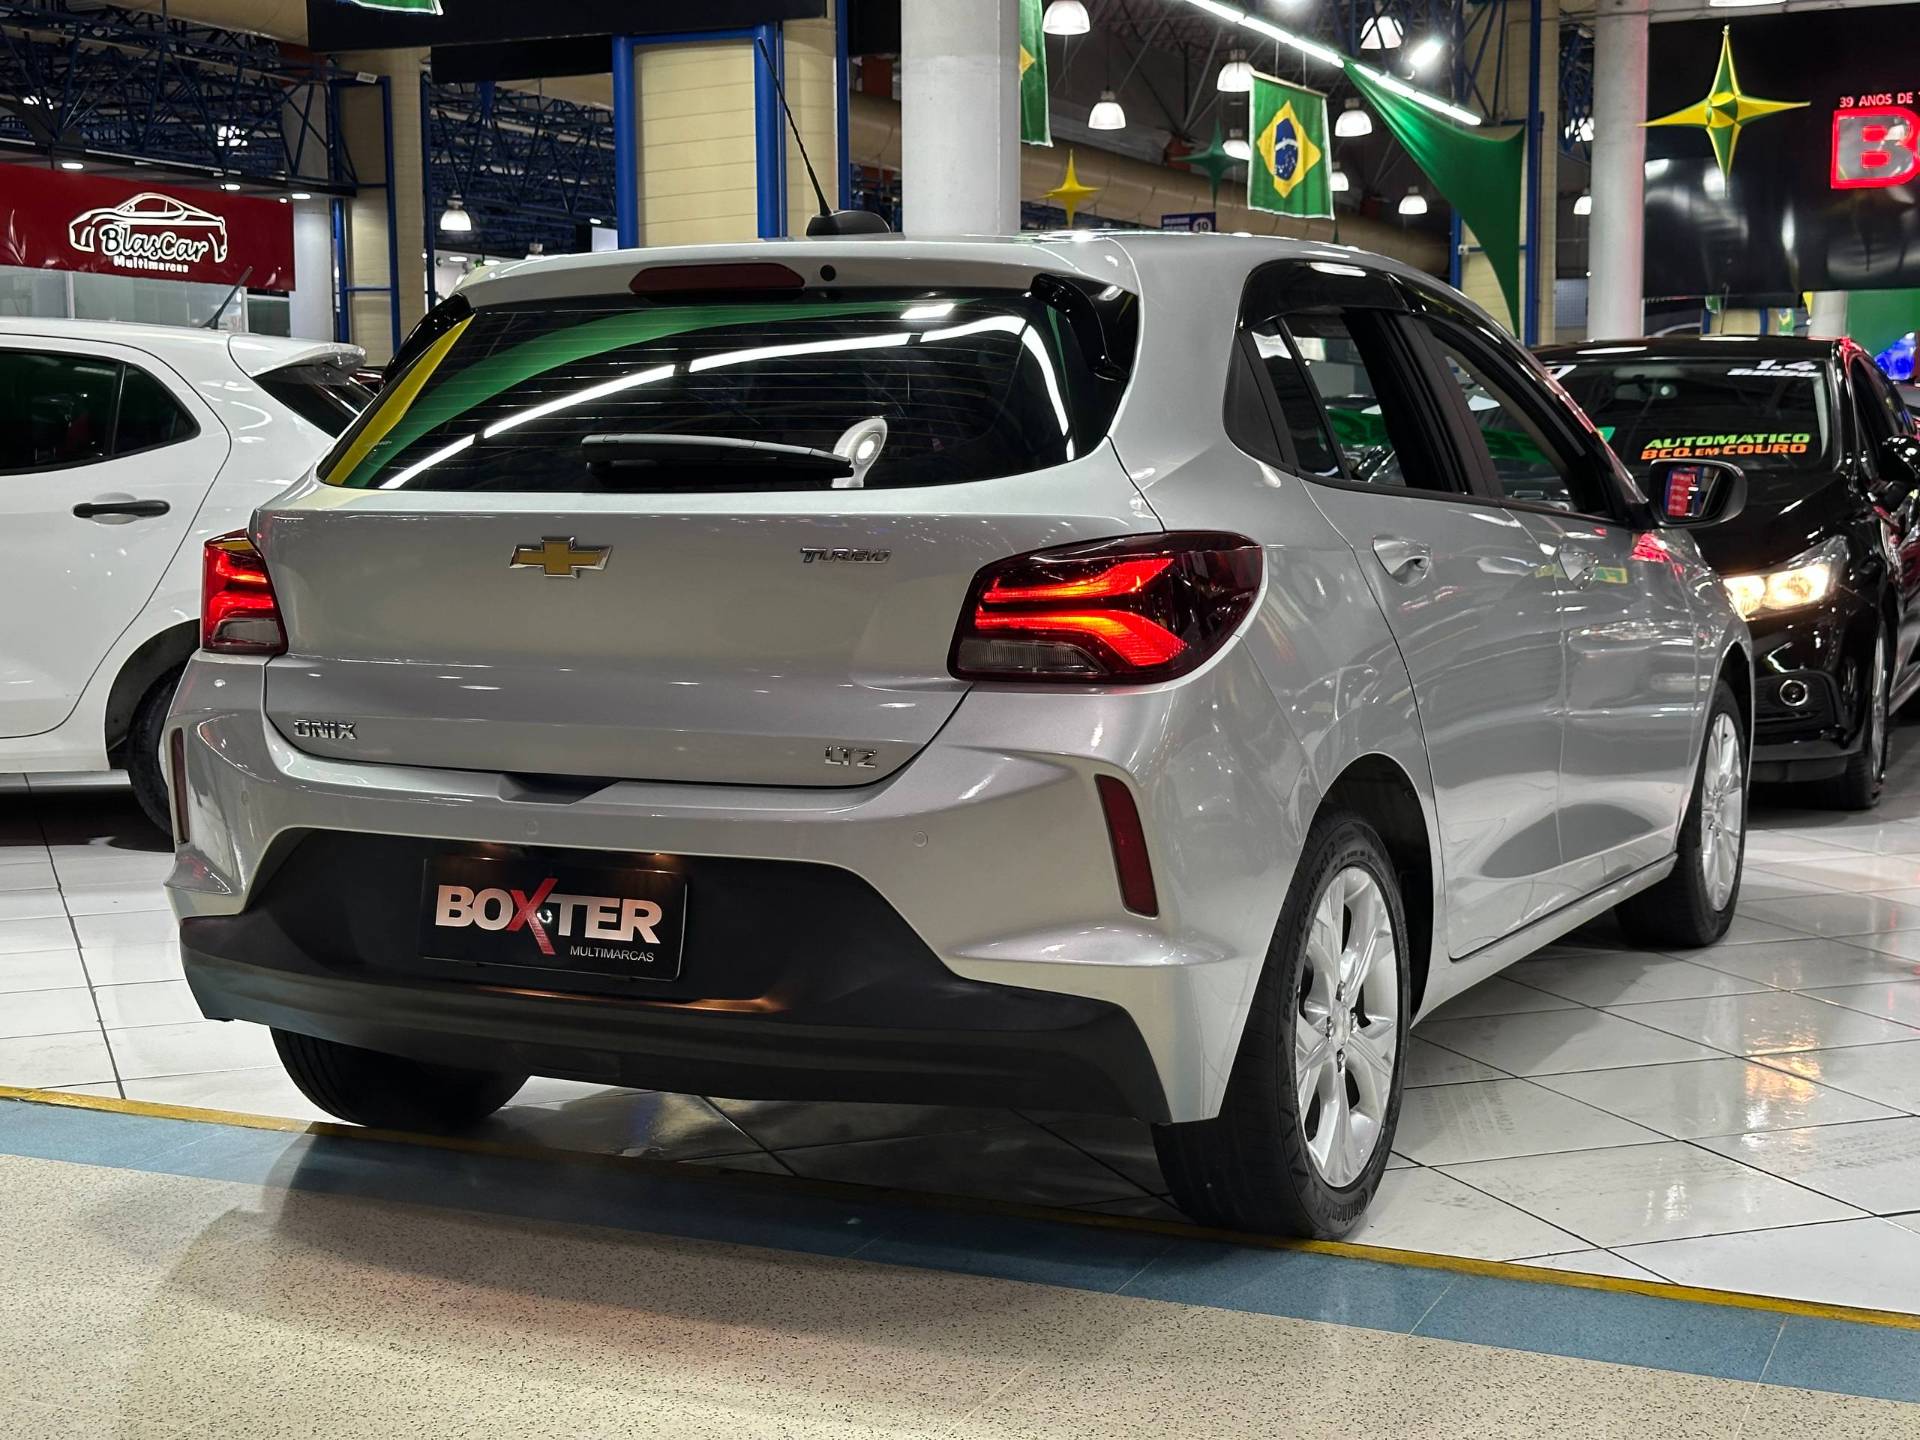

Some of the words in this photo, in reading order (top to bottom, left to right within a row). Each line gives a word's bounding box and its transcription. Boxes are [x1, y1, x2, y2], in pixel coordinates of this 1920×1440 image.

[1839, 95, 1854, 108] 39
[1859, 93, 1892, 107] ANOS
[1897, 92, 1913, 104] DE
[99, 223, 209, 262] BlasCar
[113, 255, 189, 273] Multimarcas
[1644, 433, 1811, 450] AUTOMATICO
[1695, 447, 1719, 456] EM
[1722, 443, 1807, 455] COURO
[800, 547, 892, 564] TURBO
[293, 719, 357, 740] ONIX
[824, 746, 877, 769] LTZ
[435, 877, 663, 955] BOXTER
[570, 945, 655, 962] MULTIMARCAS
